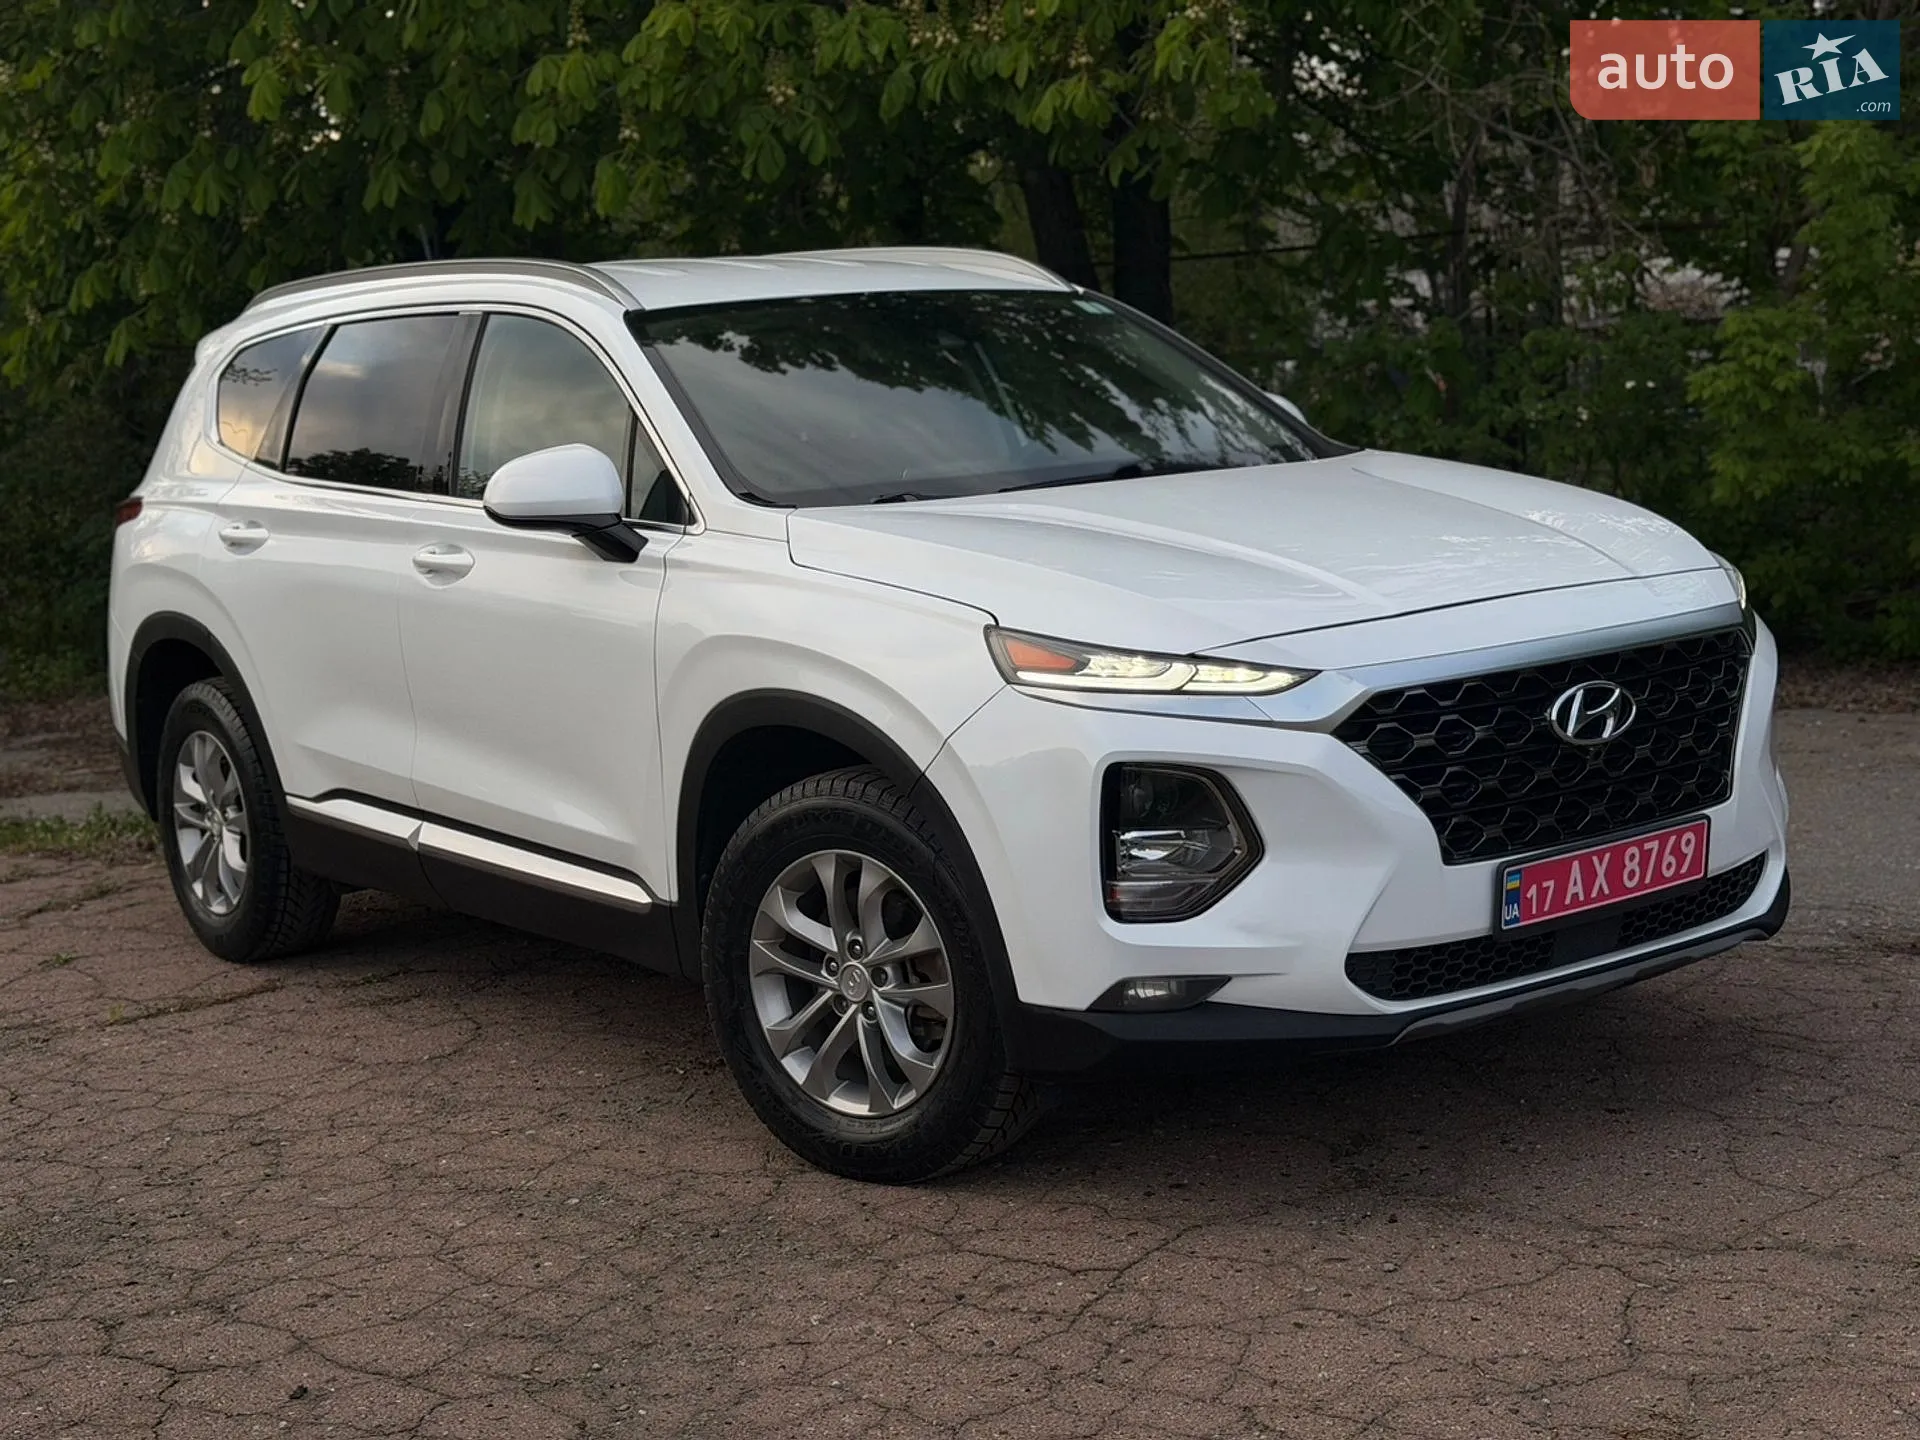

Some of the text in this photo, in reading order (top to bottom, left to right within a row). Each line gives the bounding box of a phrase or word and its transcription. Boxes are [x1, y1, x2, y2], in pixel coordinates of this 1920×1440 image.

[1526, 831, 1696, 915] 17 AX 8769
[1504, 903, 1520, 920] UA
